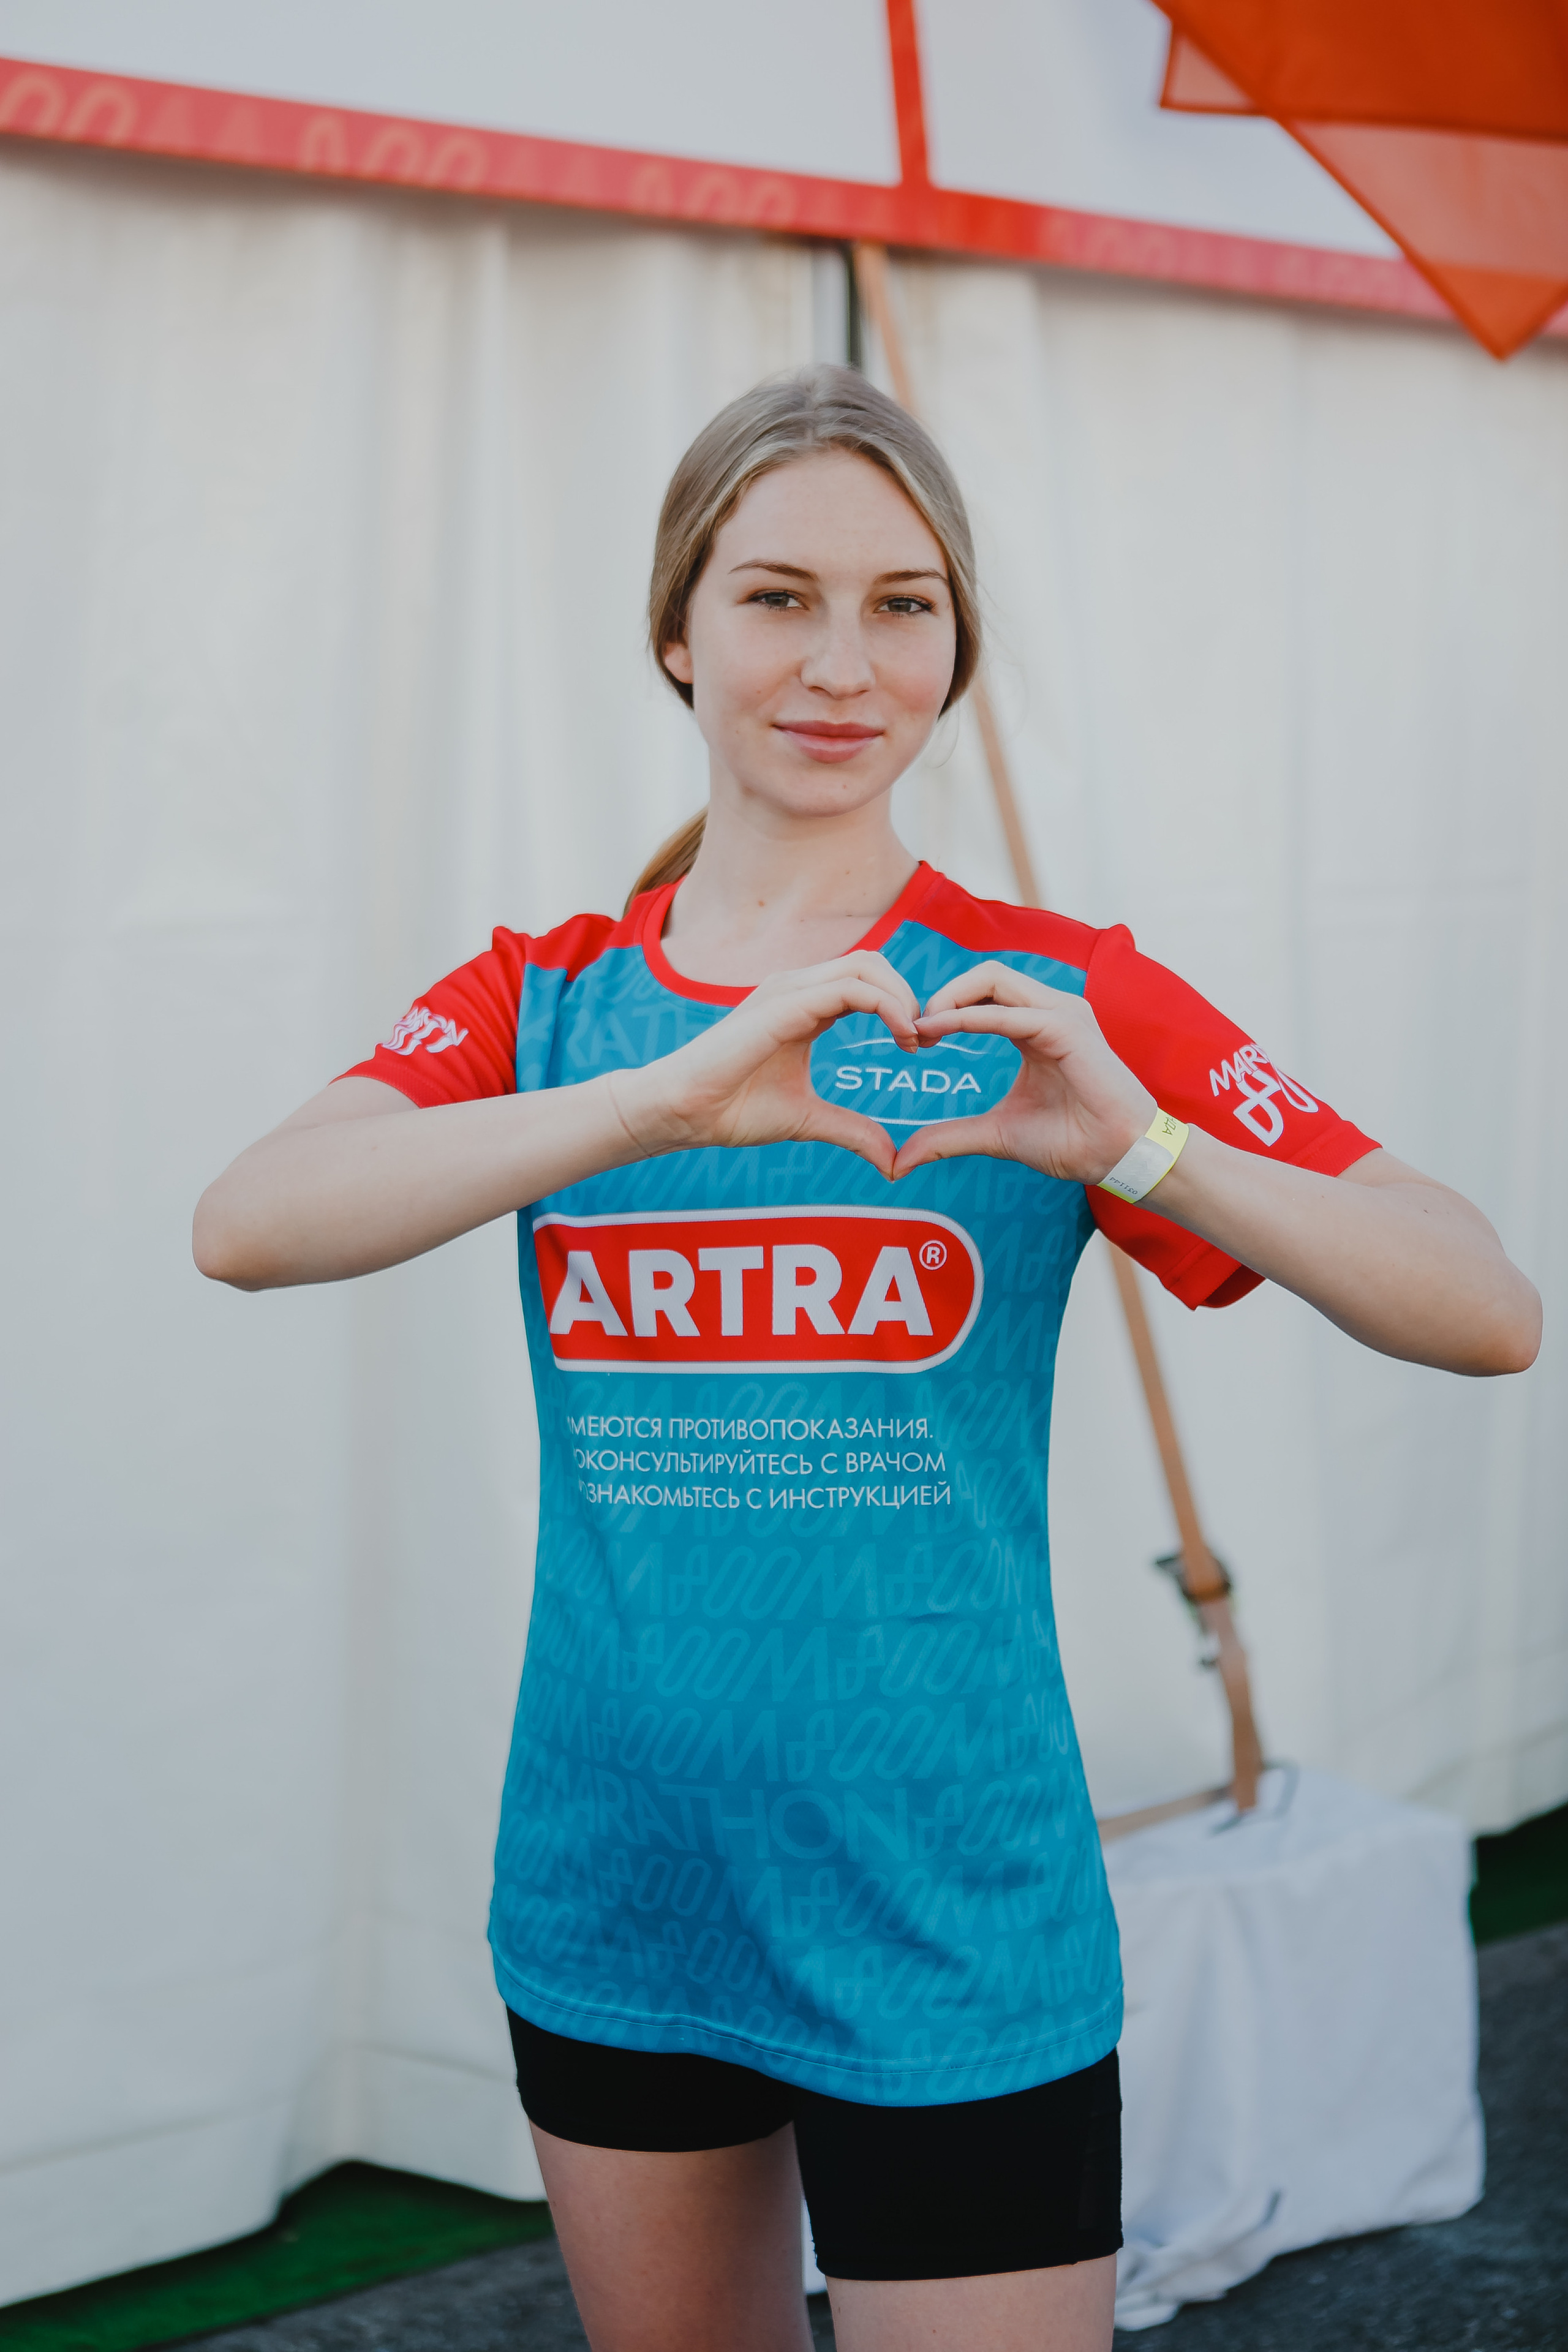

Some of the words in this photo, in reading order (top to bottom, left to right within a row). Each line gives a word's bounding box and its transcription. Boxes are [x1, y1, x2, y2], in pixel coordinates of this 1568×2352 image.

[835, 1066, 981, 1095] STADA
[1109, 1177, 1138, 1195] 031144
[669, 1417, 933, 1441] ПРОТИВОПОКАЗАНИЯ.
[573, 1449, 813, 1475] ОКОНСУЛЬТИРУЙТЕСЬ
[821, 1452, 839, 1474] С
[846, 1451, 946, 1474] ВРАЧОМ
[746, 1488, 762, 1509] С
[769, 1481, 951, 1510] ИНСТРУКЦИЕЙ
